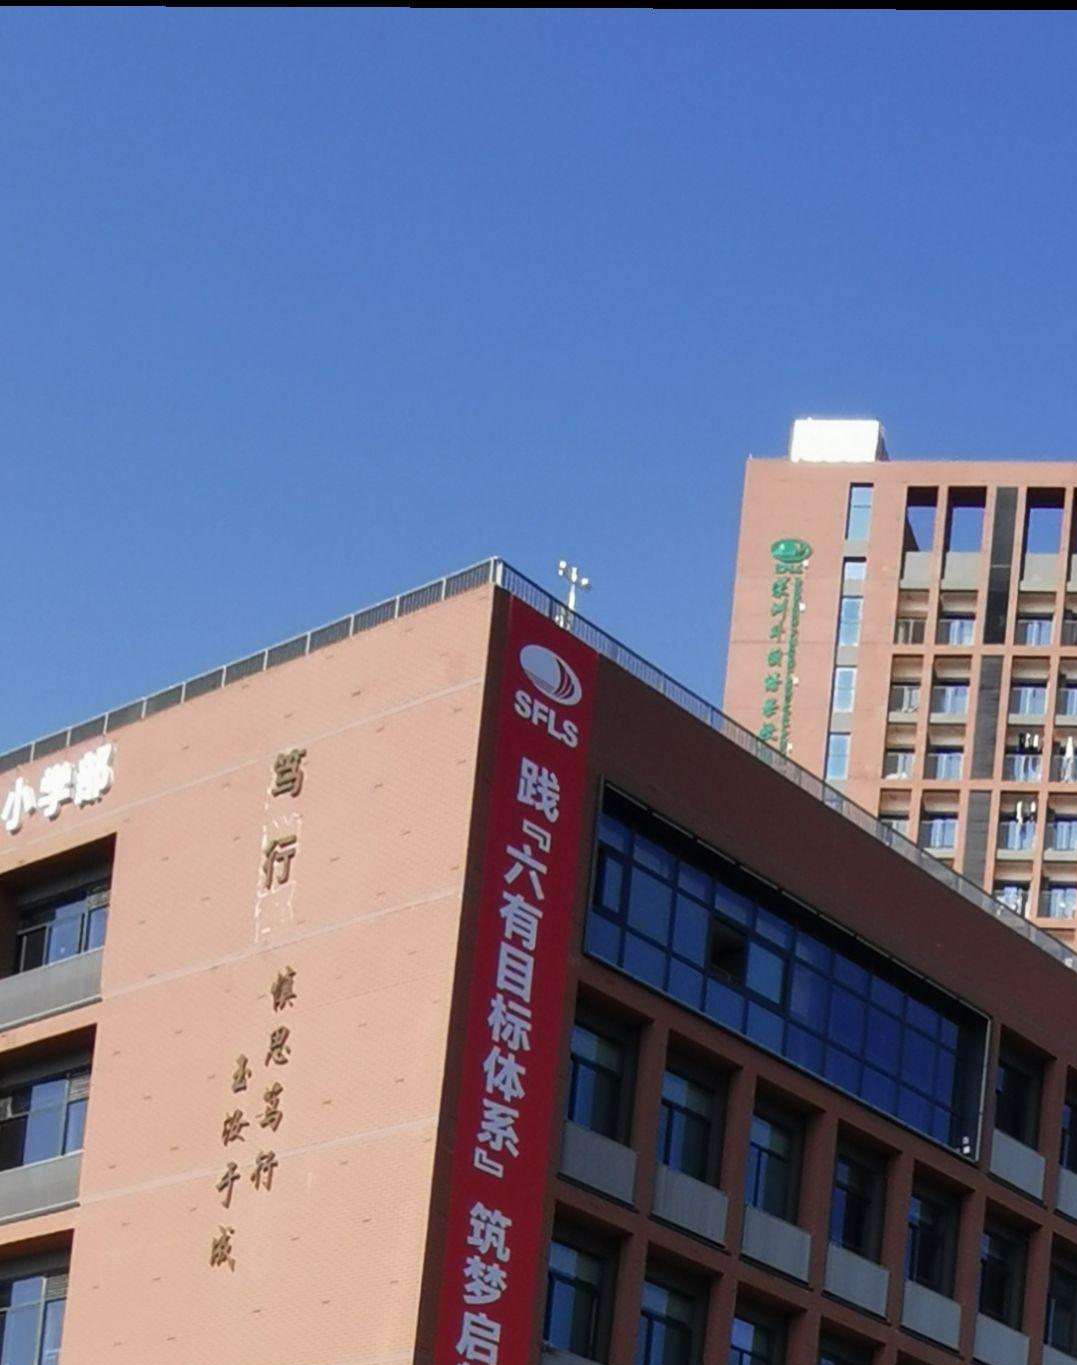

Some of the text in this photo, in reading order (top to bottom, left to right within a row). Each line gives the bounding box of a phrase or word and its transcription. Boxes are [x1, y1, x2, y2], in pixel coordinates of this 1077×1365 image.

[514, 690, 579, 748] SFLS
[1, 743, 113, 832] 小学部
[262, 749, 307, 891] 笃行
[472, 756, 561, 1179] 践『六有目标体系』
